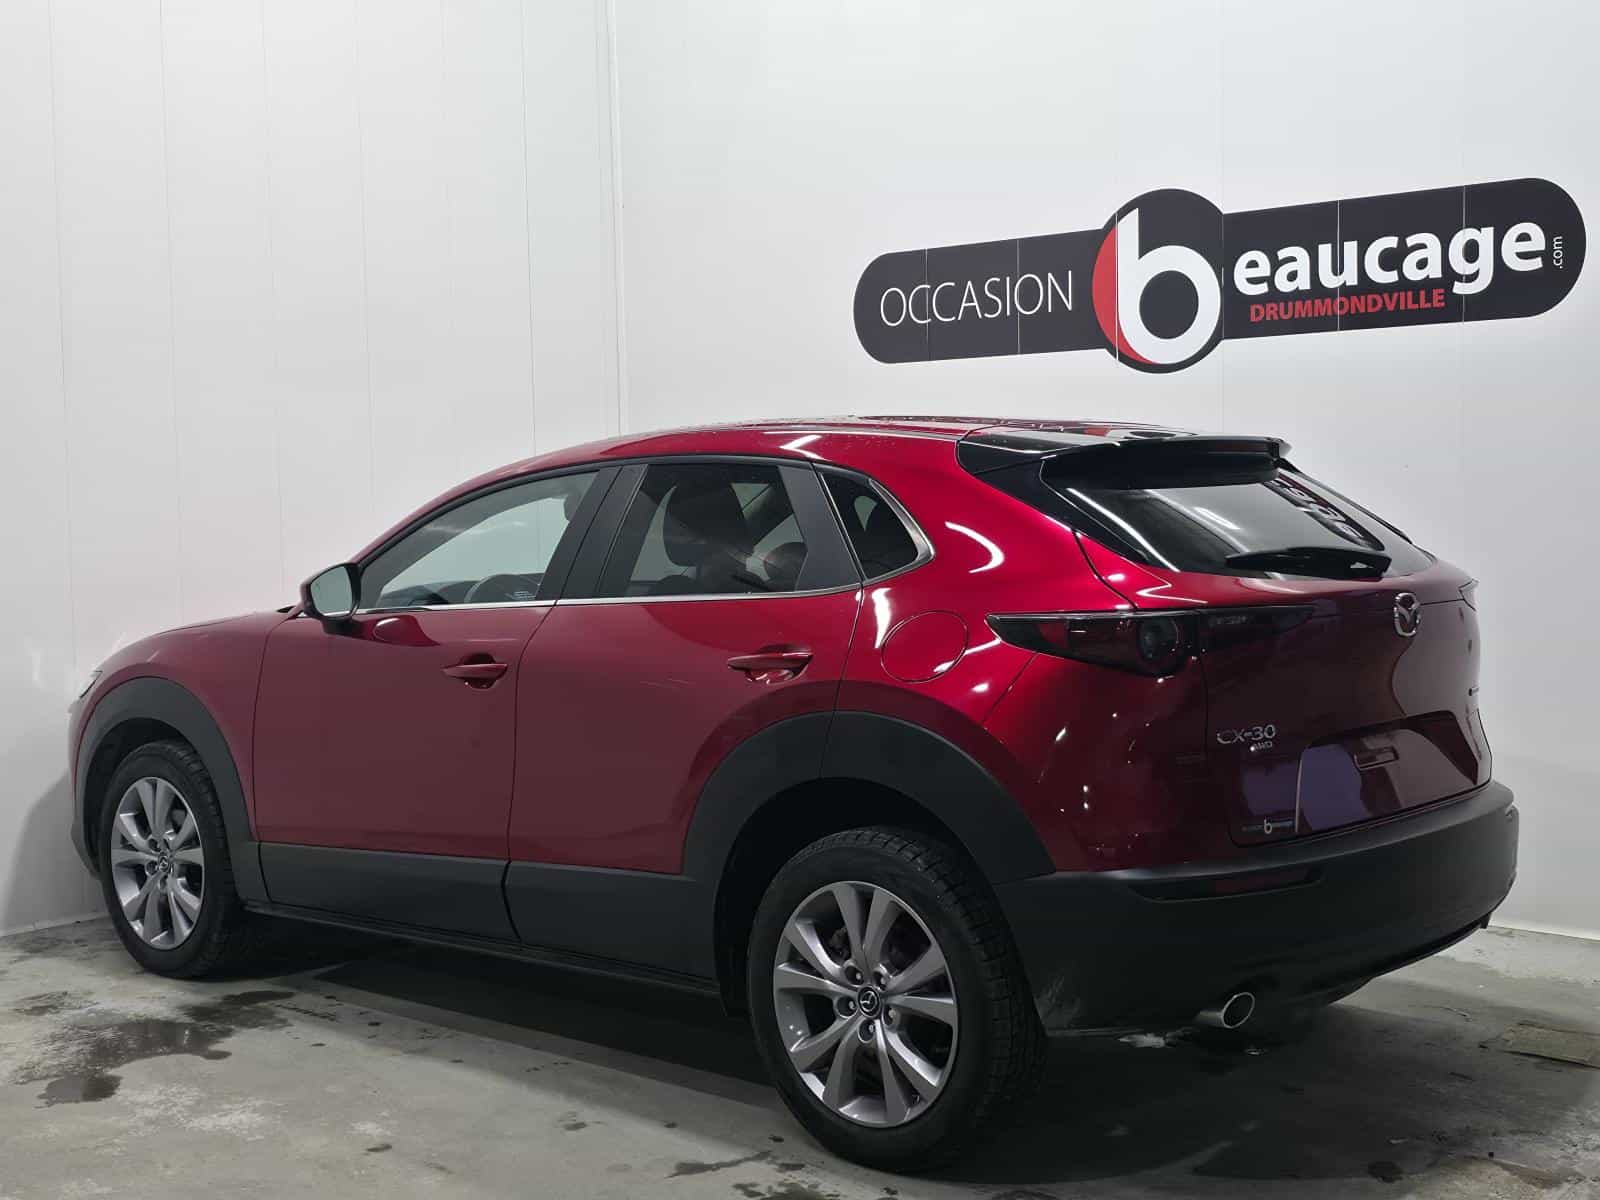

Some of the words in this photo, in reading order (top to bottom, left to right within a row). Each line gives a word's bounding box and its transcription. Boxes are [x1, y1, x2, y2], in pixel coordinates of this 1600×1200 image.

[1552, 235, 1563, 269] .com
[880, 269, 1073, 327] OCCASION
[1249, 288, 1446, 323] DRUMMONDVILLE
[1216, 723, 1277, 744] CX-30
